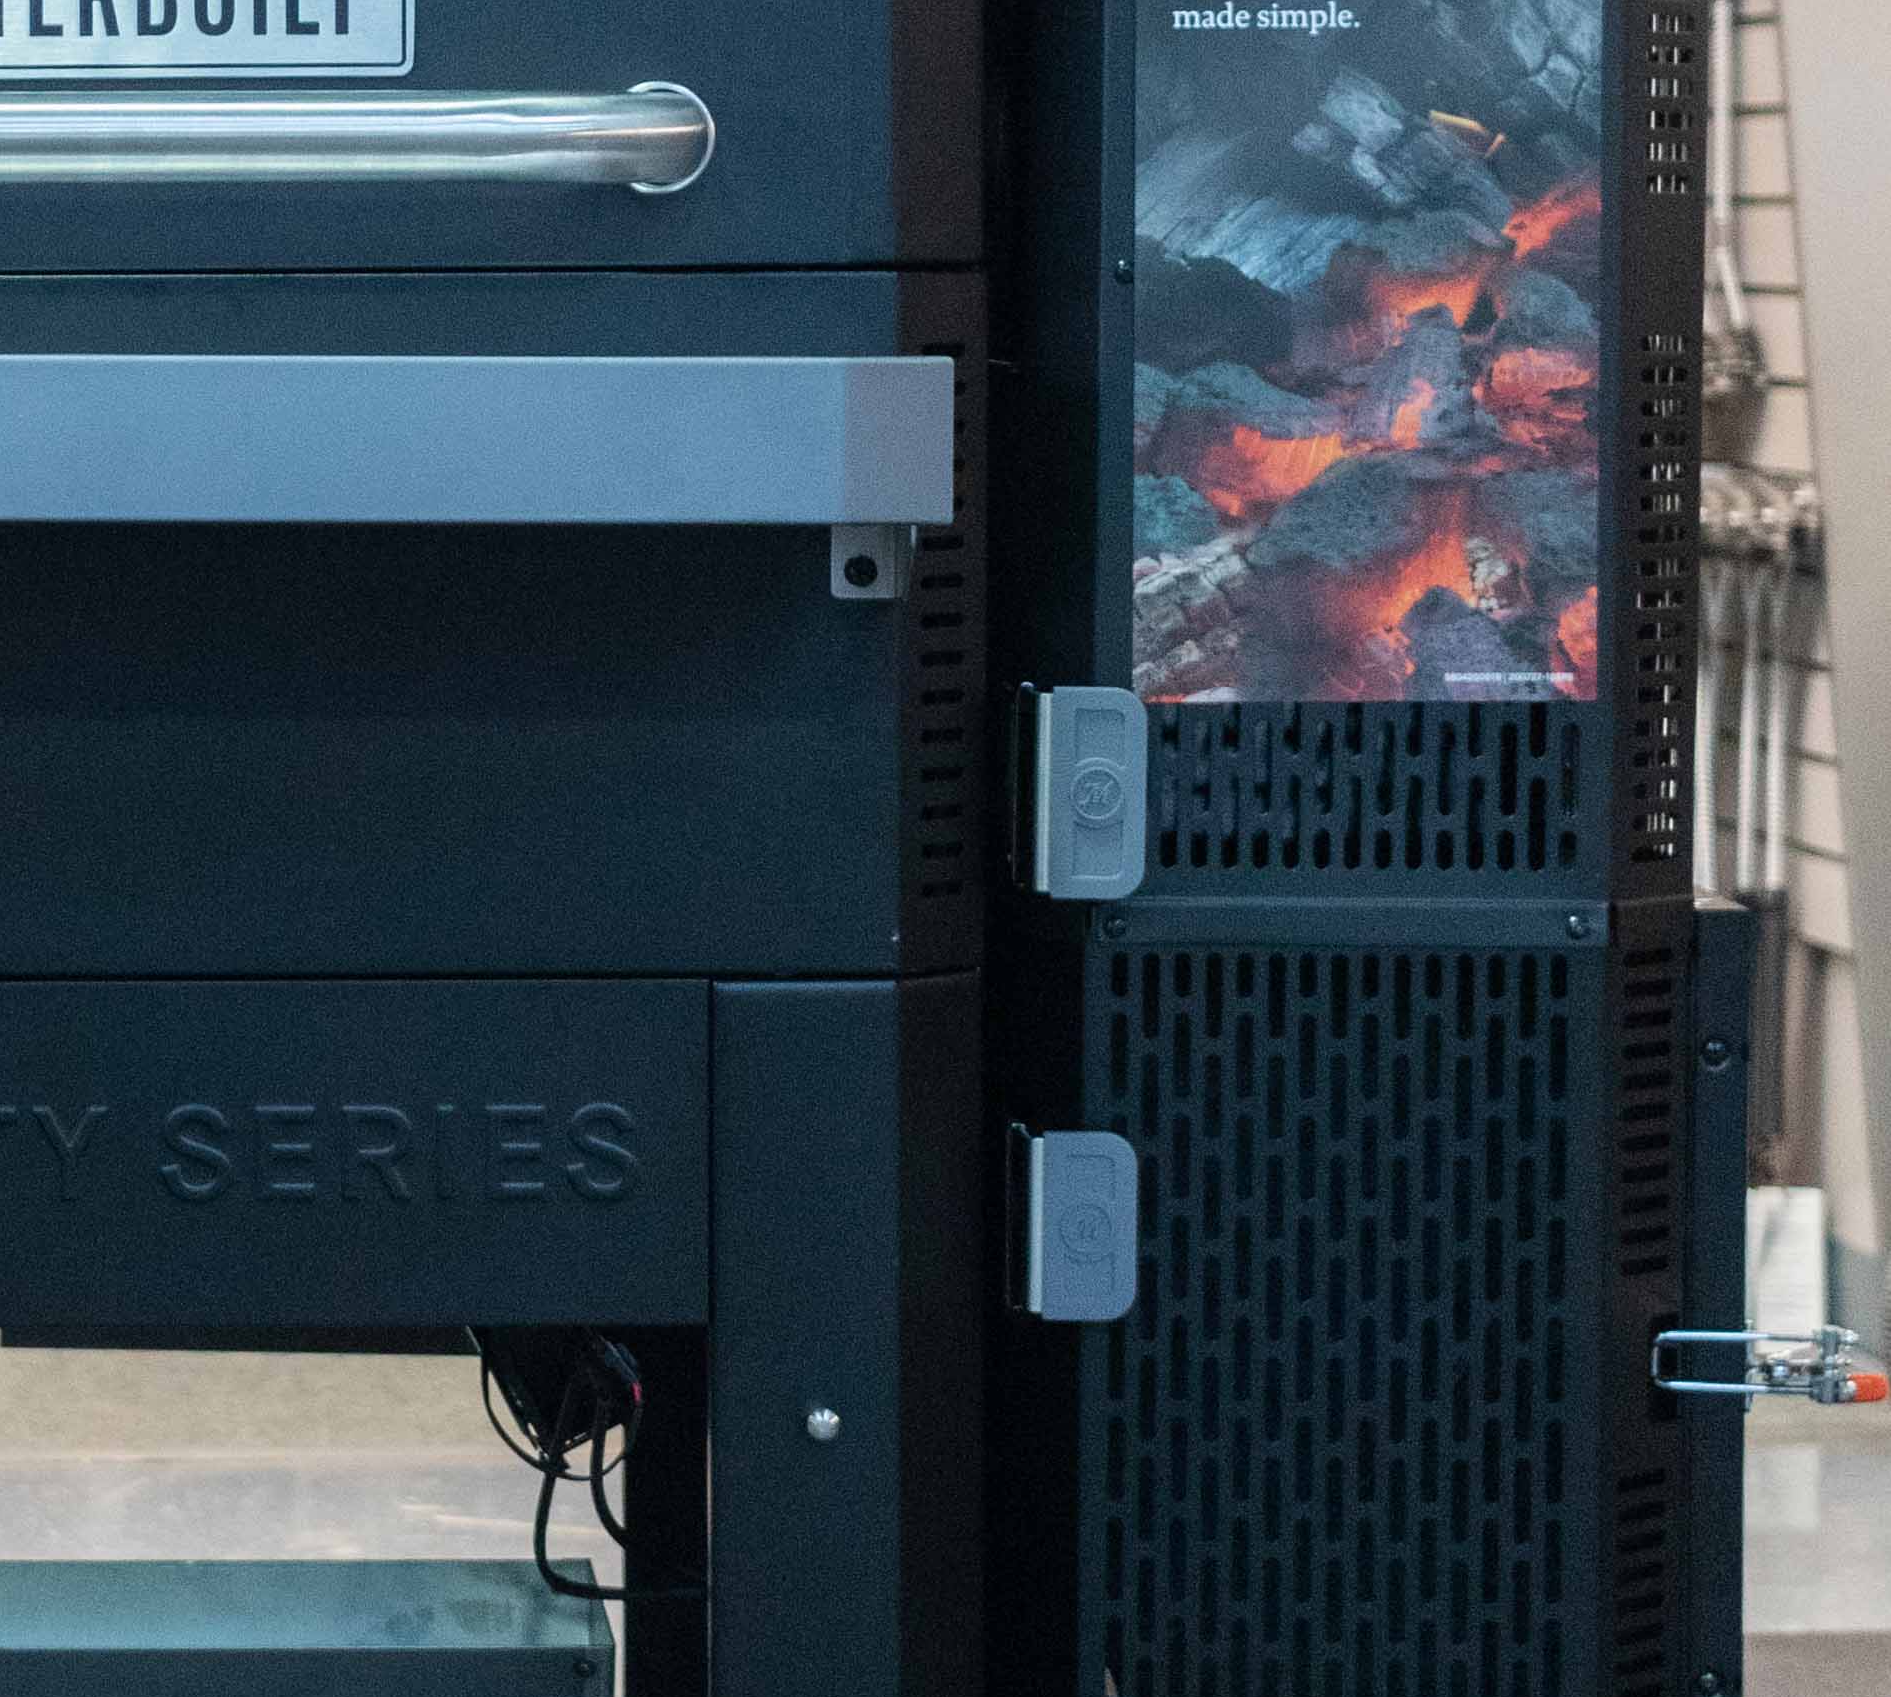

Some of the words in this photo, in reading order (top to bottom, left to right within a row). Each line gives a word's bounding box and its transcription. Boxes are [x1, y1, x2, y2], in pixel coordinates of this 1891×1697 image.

[1172, 0, 1252, 29] made
[1257, 0, 1361, 34] simple.
[156, 1100, 643, 1208] SERIES
